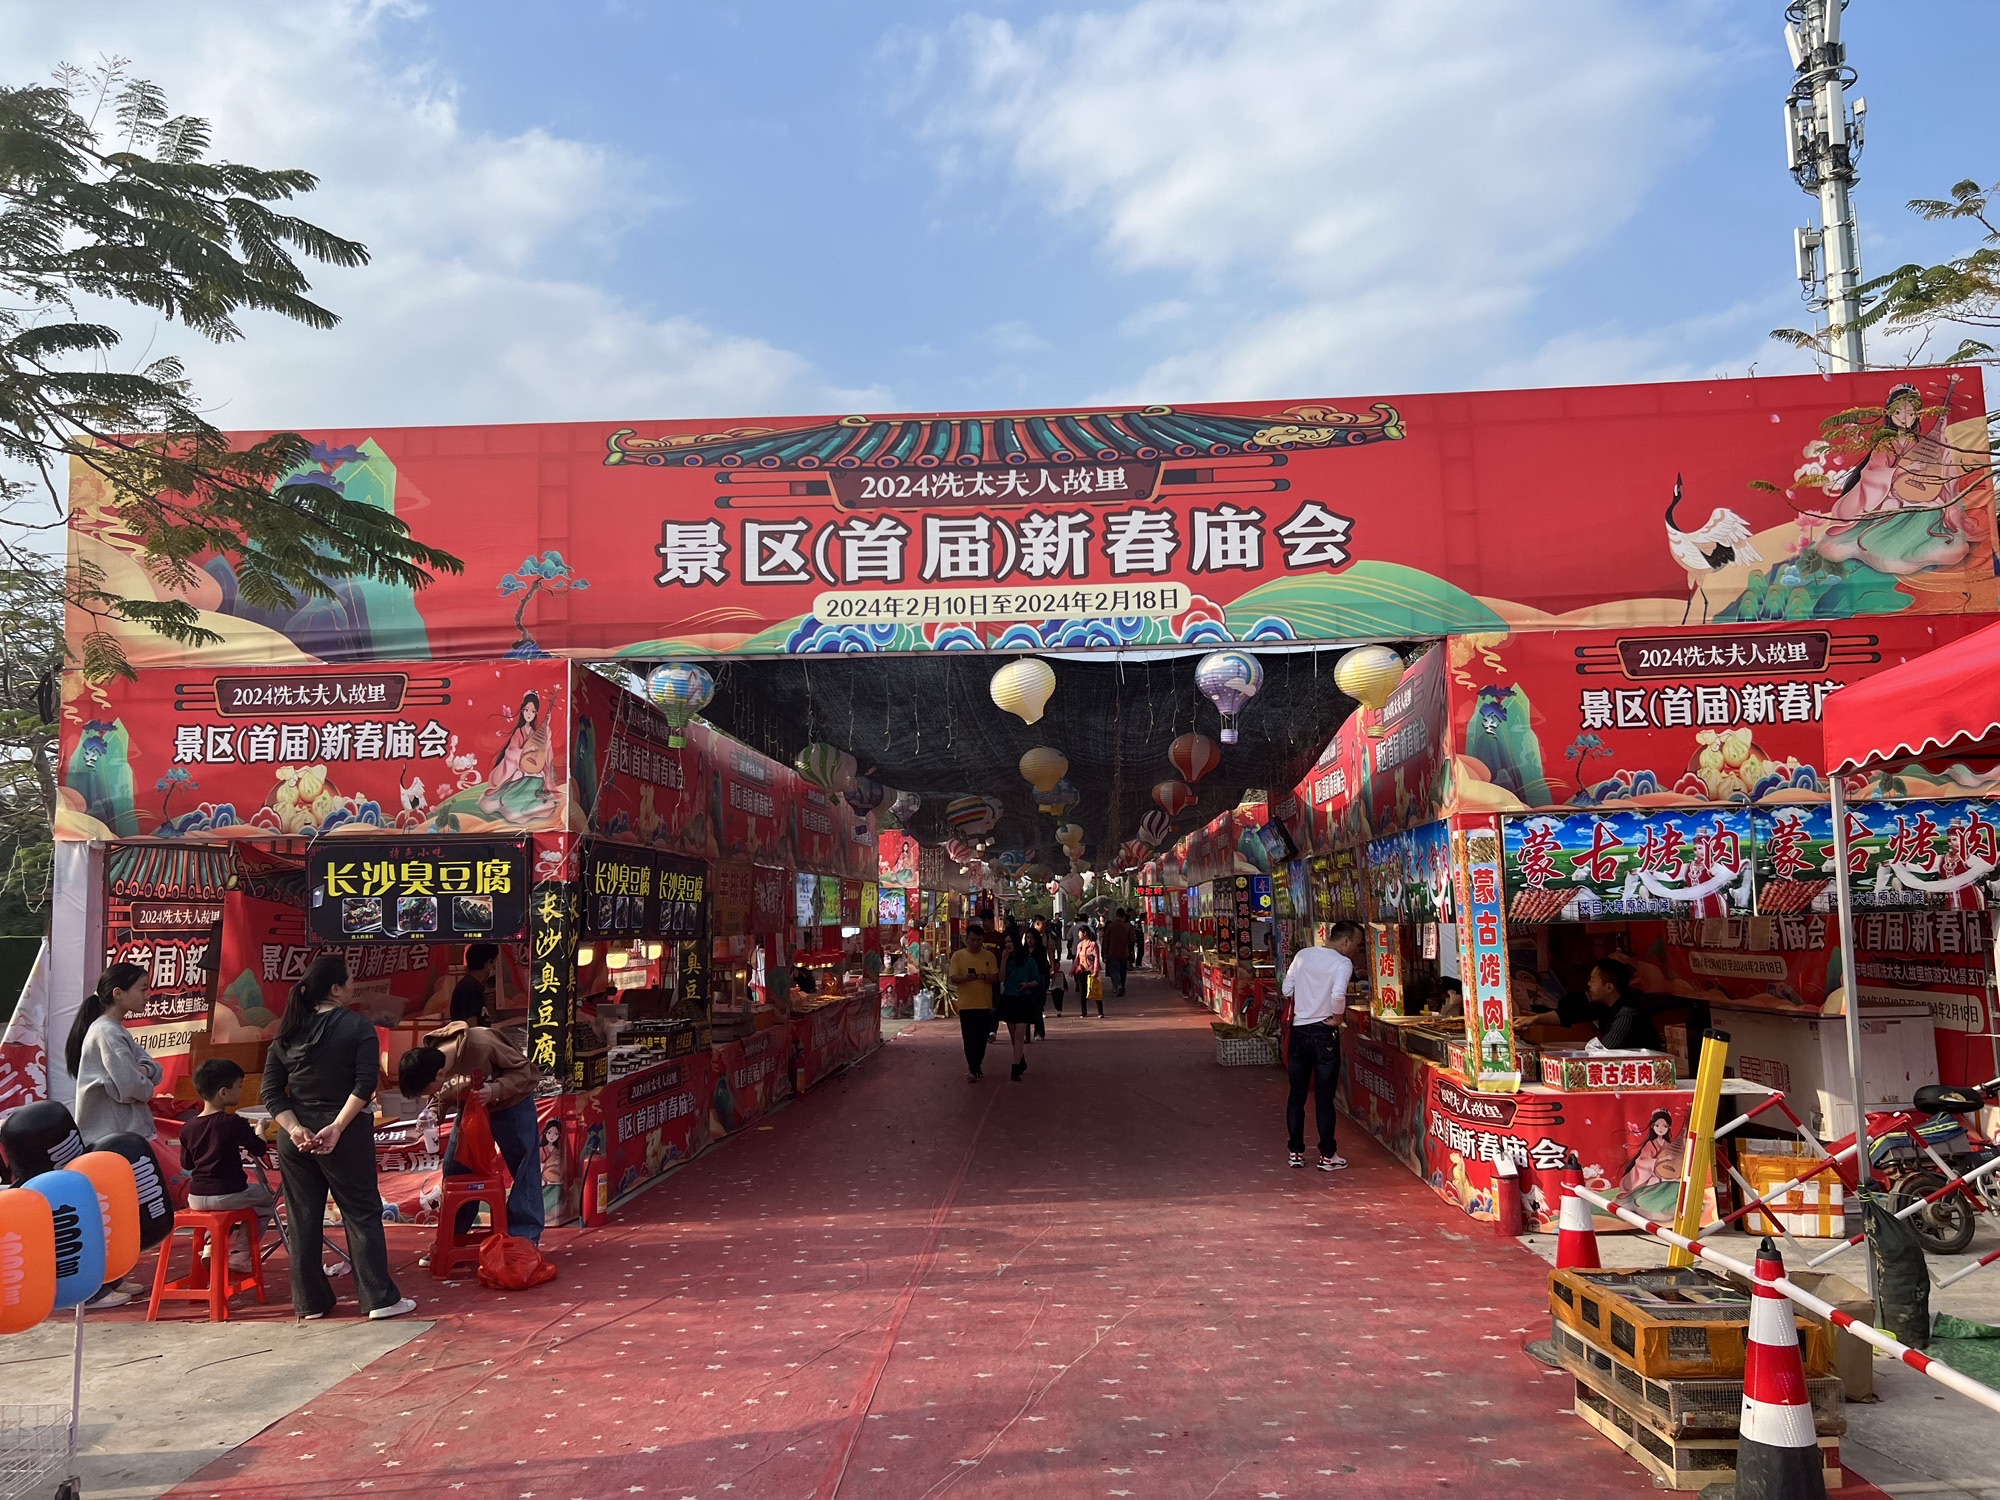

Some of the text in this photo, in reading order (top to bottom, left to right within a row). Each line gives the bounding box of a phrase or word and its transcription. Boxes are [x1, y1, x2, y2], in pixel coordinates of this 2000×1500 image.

[654, 503, 1351, 584] 景区(首届)新春庙会
[826, 588, 1178, 618] 2024年2月10日至2024年2月18日
[173, 720, 450, 764] 景区(首届)新春庙会
[1517, 819, 1741, 887] 蒙古烤肉
[1766, 811, 1997, 878] 蒙古烤肉
[323, 858, 512, 897] 长沙臭豆腐
[595, 861, 651, 896] 长沙臭豆腐
[658, 870, 704, 902] 长沙臭豆腐
[1472, 866, 1505, 1032] 蒙古烤肉
[531, 892, 564, 1068] 长沙臭豆腐
[1586, 1061, 1655, 1087] 蒙古烤肉
